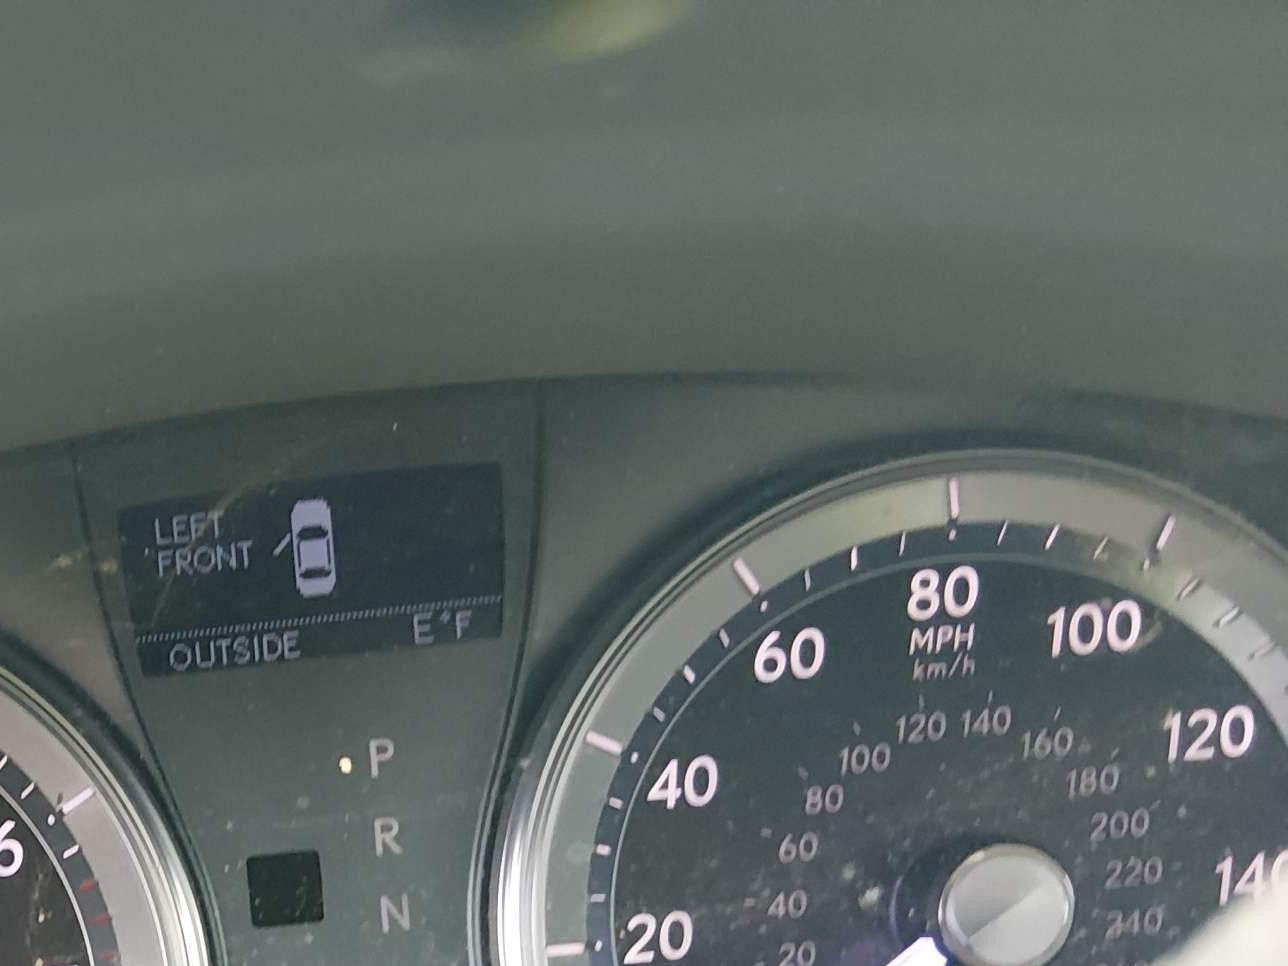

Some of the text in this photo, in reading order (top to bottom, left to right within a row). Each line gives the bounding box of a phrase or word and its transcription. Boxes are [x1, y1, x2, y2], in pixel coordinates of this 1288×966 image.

[155, 512, 225, 547] LEFT
[158, 540, 253, 577] FRONT
[907, 566, 979, 620] 80
[909, 624, 976, 654] MPH
[1047, 600, 1142, 657] 100
[169, 630, 302, 672] OUTSIDE
[753, 627, 825, 684] 60
[913, 656, 976, 681] km/h
[896, 713, 947, 745] 120
[961, 705, 1012, 737] 140
[1163, 705, 1255, 763] 120
[368, 738, 395, 779] P
[840, 743, 891, 775] 100
[1021, 728, 1073, 759] 160
[647, 755, 718, 809] 40
[1068, 766, 1119, 798] 180
[805, 785, 844, 815] 80
[373, 816, 402, 857] R
[1090, 808, 1150, 841] 200
[778, 833, 819, 863] 60
[1104, 856, 1162, 890] 220
[380, 893, 411, 934] N
[768, 889, 807, 919] 40
[624, 910, 693, 965] 20
